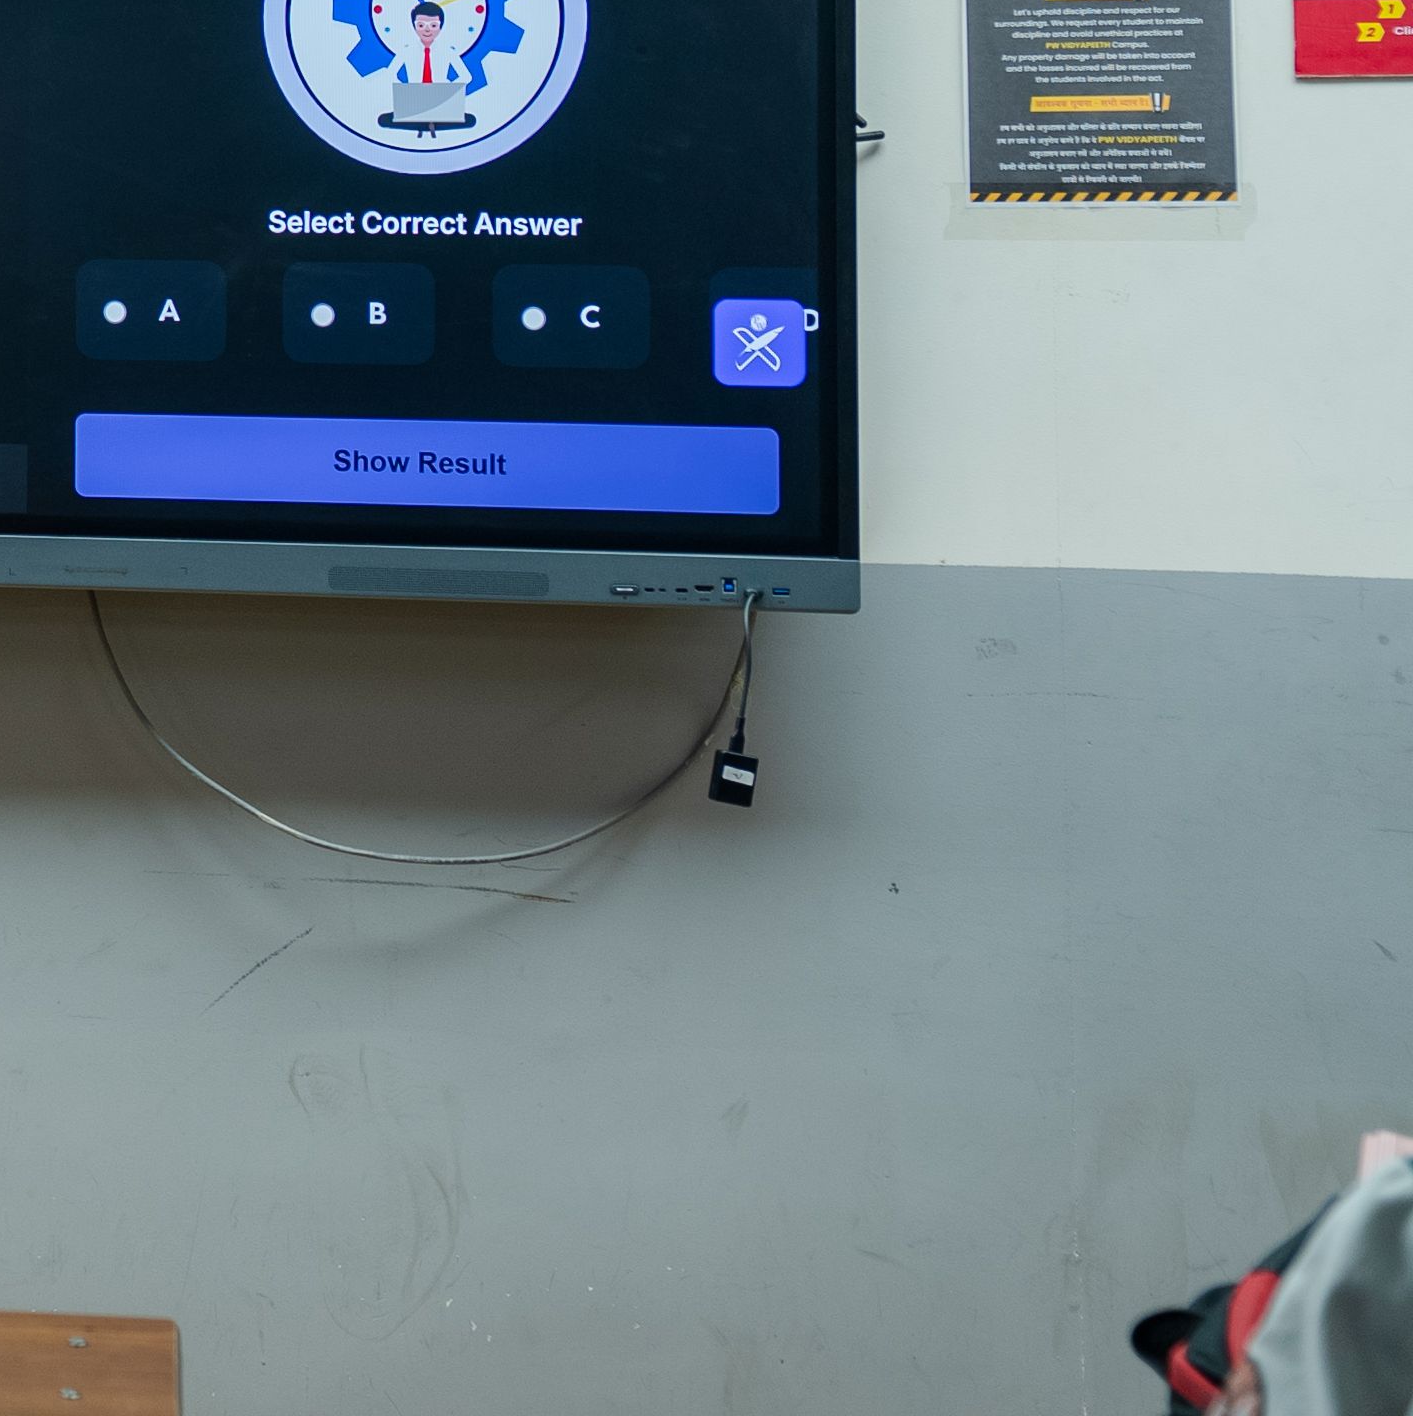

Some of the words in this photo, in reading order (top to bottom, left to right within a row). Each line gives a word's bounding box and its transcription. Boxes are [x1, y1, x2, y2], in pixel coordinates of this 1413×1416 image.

[1033, 8, 1061, 17] uphold
[1062, 8, 1101, 16] discipline
[1121, 7, 1152, 15] respect
[1153, 6, 1165, 14] for
[1065, 20, 1097, 28] request
[1097, 19, 1121, 27] every
[1165, 17, 1204, 25] maintain
[1366, 27, 1376, 37] 2
[1060, 41, 1111, 49] VIDYAPEETH
[1115, 135, 1177, 144] VIDYAPEETH
[268, 211, 355, 235] Select
[362, 211, 467, 236] Correct
[473, 212, 583, 238] Answer
[158, 299, 181, 323] A
[368, 302, 387, 326] B
[580, 305, 601, 329] C
[333, 449, 410, 475] Show
[418, 451, 507, 478] Result
